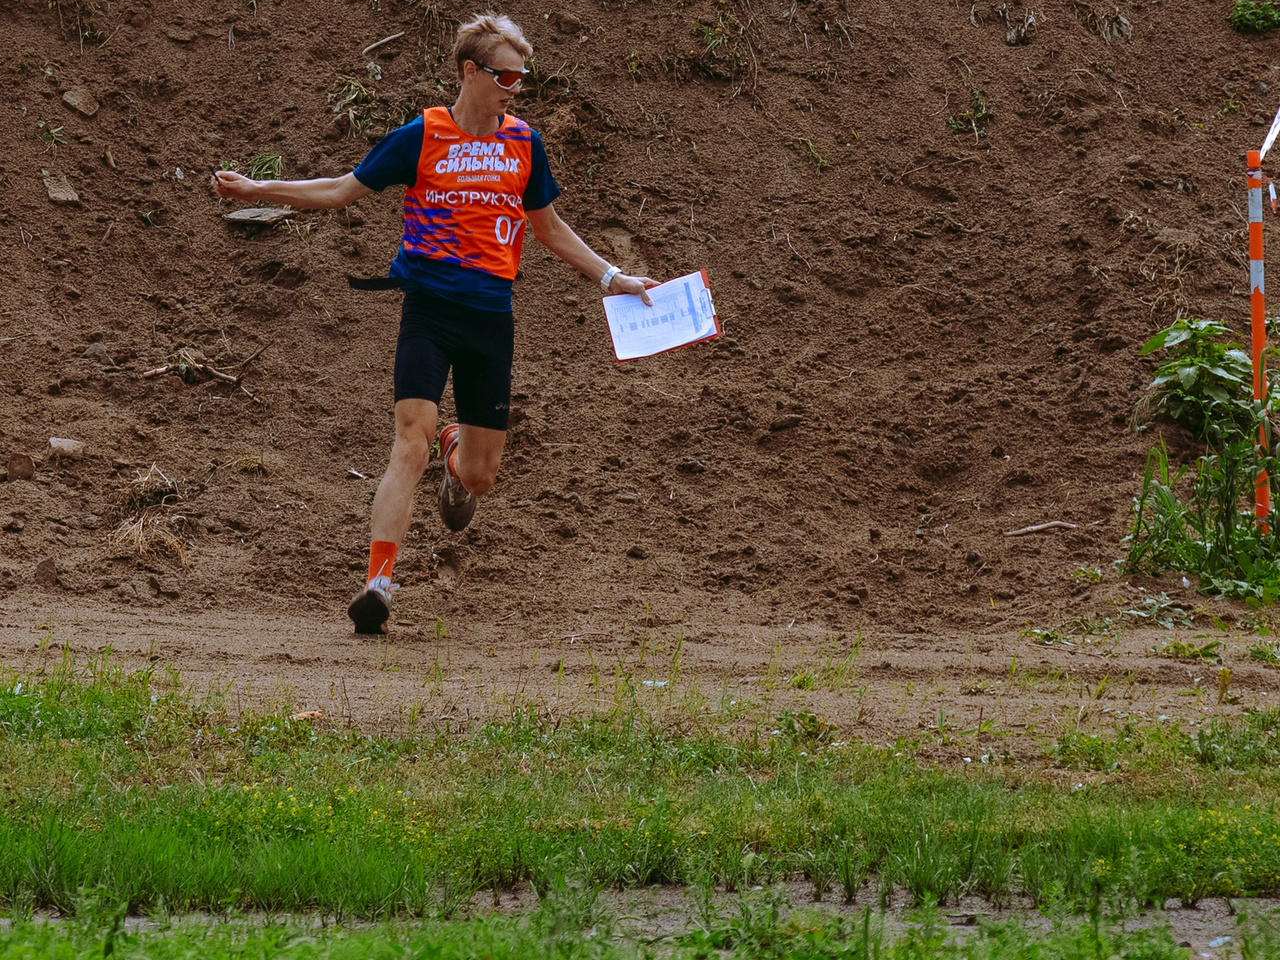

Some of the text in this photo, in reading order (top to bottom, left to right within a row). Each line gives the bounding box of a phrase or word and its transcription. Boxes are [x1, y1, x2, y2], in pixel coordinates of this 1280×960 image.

[447, 141, 505, 159] ВРЕМЯ
[435, 156, 520, 174] СИЛЬНЫХ
[425, 189, 523, 209] ИНСТРУКТОР
